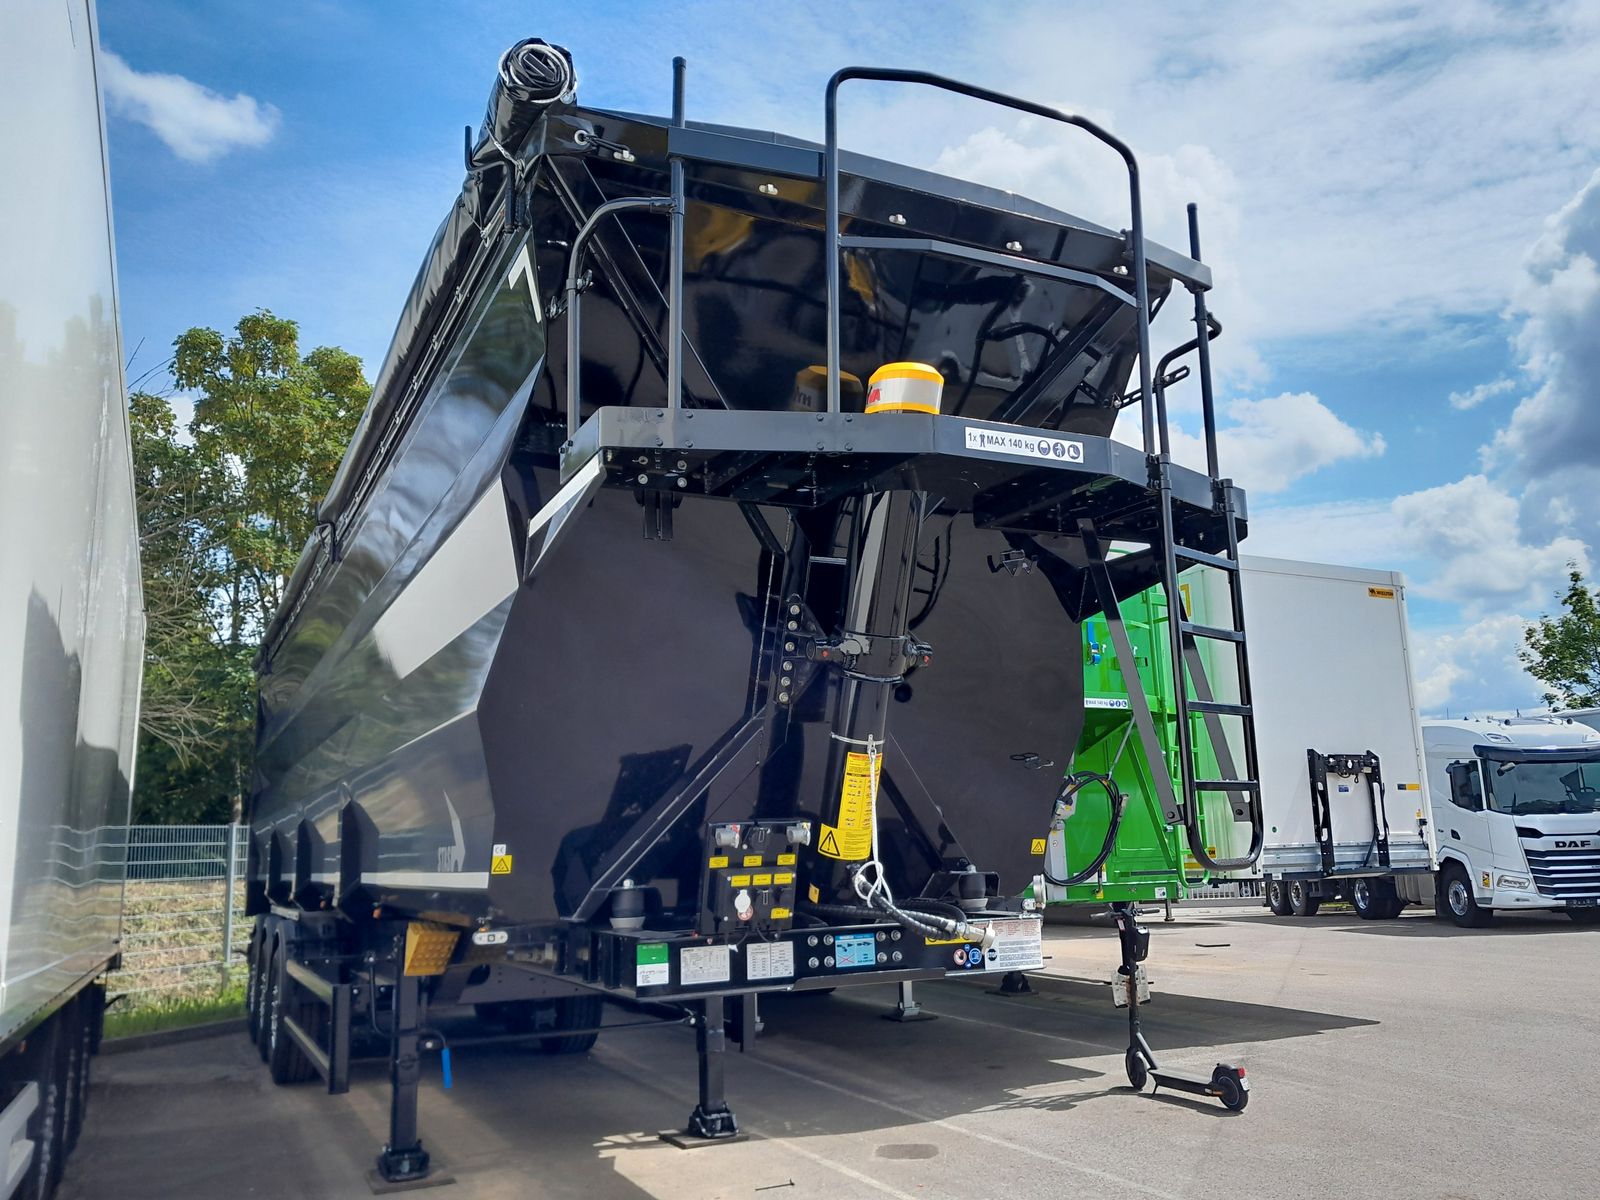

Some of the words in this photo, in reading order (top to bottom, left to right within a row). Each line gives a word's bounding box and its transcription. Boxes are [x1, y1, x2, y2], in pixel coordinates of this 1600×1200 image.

[968, 432, 977, 442] 1x
[986, 435, 1006, 447] MAX
[1008, 438, 1022, 449] 140
[1025, 440, 1035, 453] kg
[1554, 840, 1591, 848] DAF
